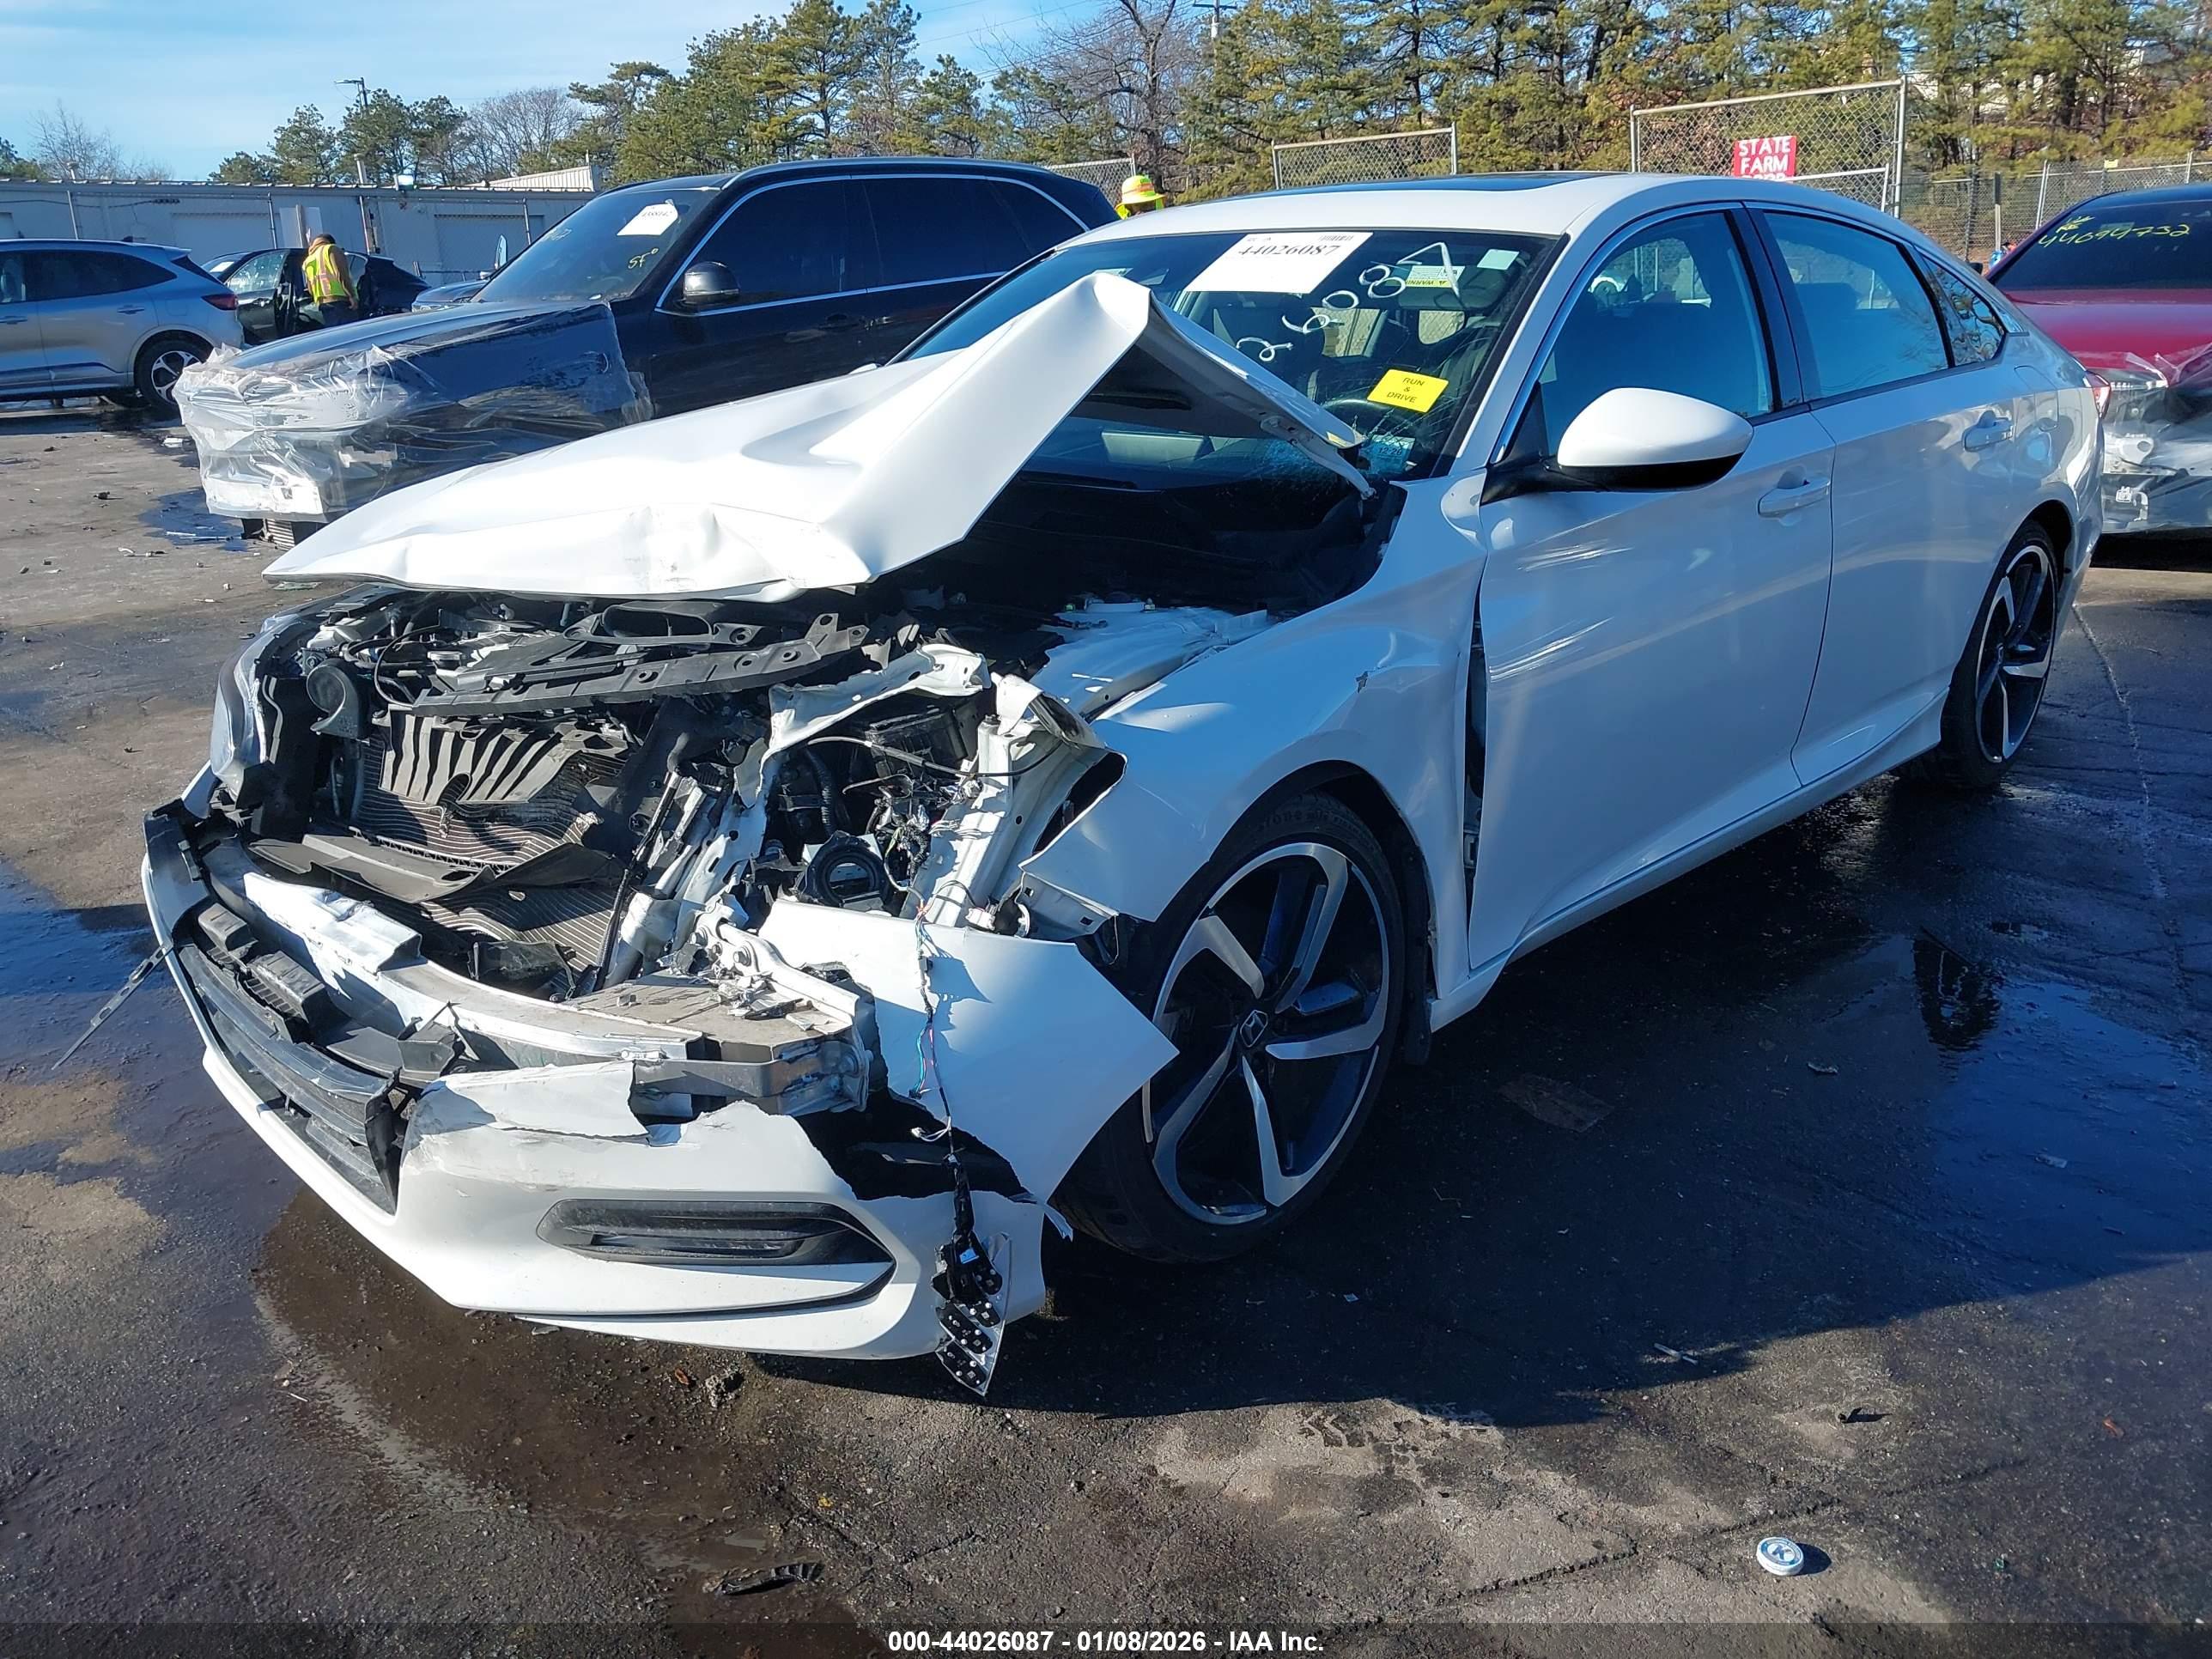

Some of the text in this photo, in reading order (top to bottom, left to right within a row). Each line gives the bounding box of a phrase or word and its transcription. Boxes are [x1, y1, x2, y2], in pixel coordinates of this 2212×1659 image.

[1738, 137, 1791, 156] STATE
[1740, 155, 1789, 174] FARM
[1238, 245, 1341, 256] 44026087
[1387, 392, 1417, 403] DRIVE
